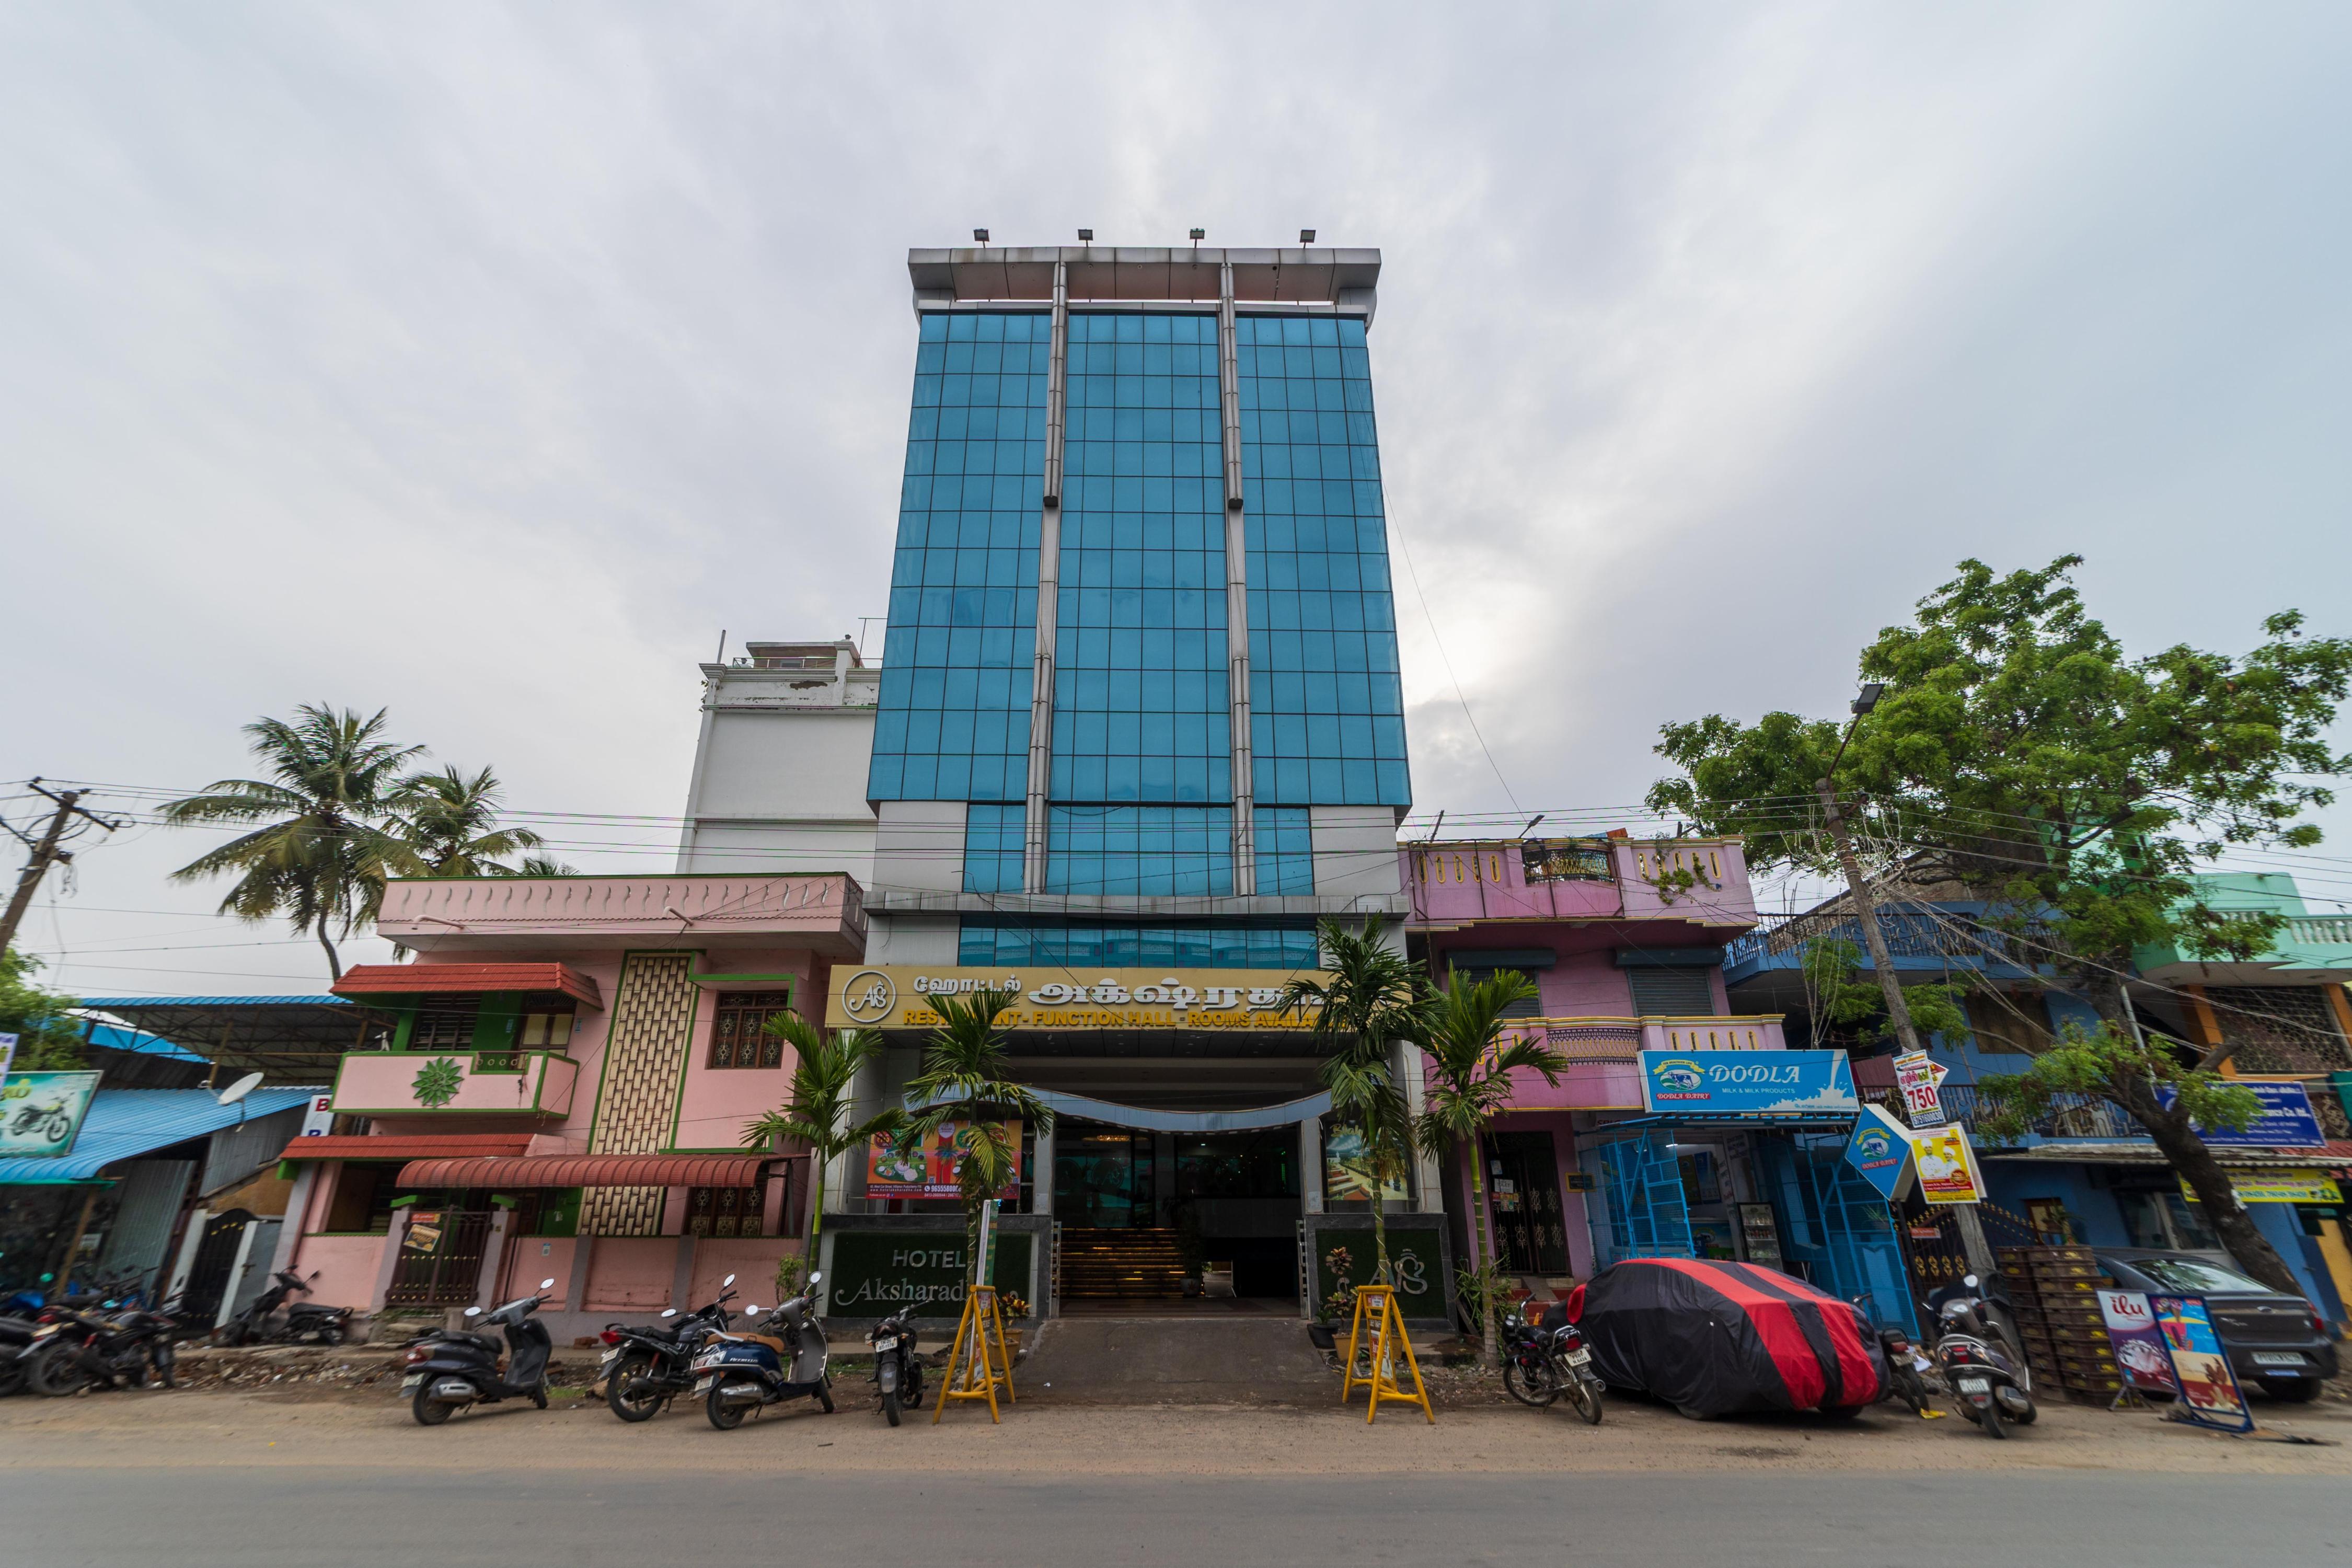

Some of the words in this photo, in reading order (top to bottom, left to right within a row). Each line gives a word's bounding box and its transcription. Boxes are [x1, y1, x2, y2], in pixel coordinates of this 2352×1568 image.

[903, 1010, 1022, 1025] RESNT
[1033, 1011, 1124, 1026] FUNCTION
[1128, 1012, 1175, 1027] HALL
[1188, 1011, 1250, 1028] ROOMS
[1255, 1012, 1346, 1028] AVAILA
[1710, 1065, 1801, 1083] DODLA
[1907, 1086, 1936, 1110] 750
[892, 1250, 966, 1268] HOTEL
[835, 1278, 969, 1306] Aksharad
